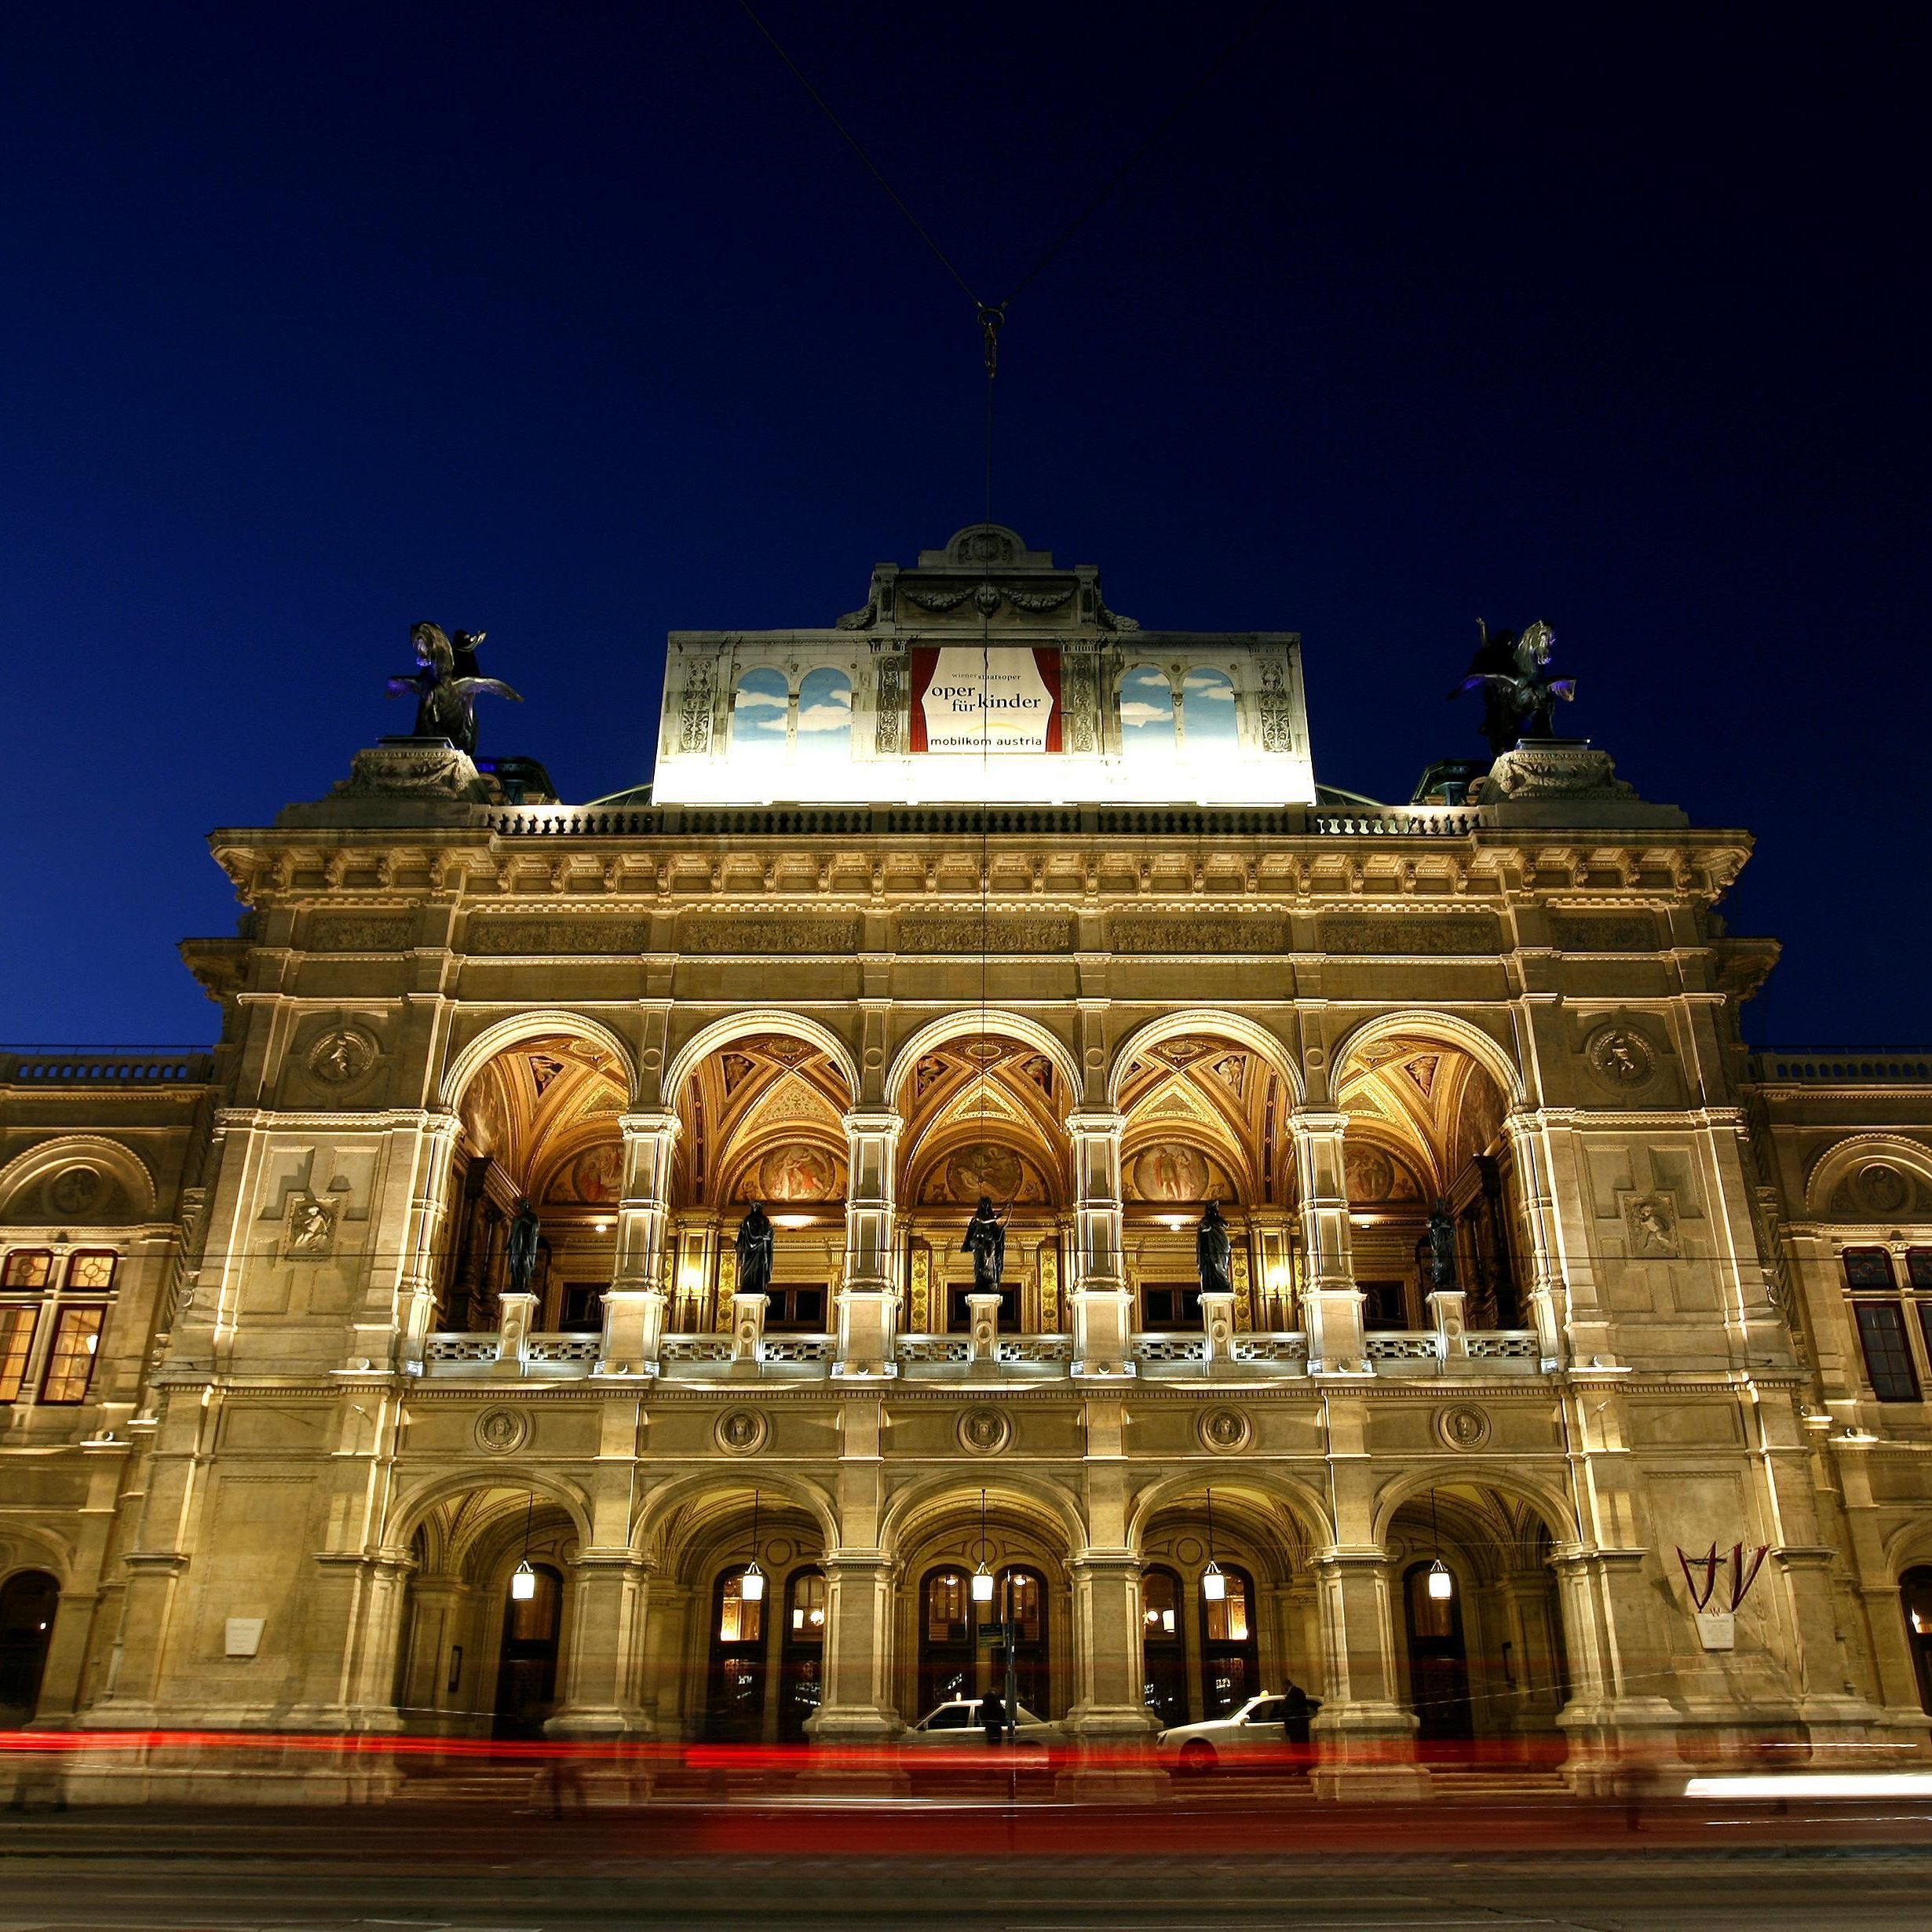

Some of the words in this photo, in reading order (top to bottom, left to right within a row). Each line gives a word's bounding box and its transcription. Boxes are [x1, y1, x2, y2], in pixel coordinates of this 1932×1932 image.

[931, 686, 976, 699] oper
[952, 699, 976, 711] für
[978, 693, 1041, 708] kinder
[930, 736, 992, 746] mobilkom
[996, 736, 1042, 746] austria
